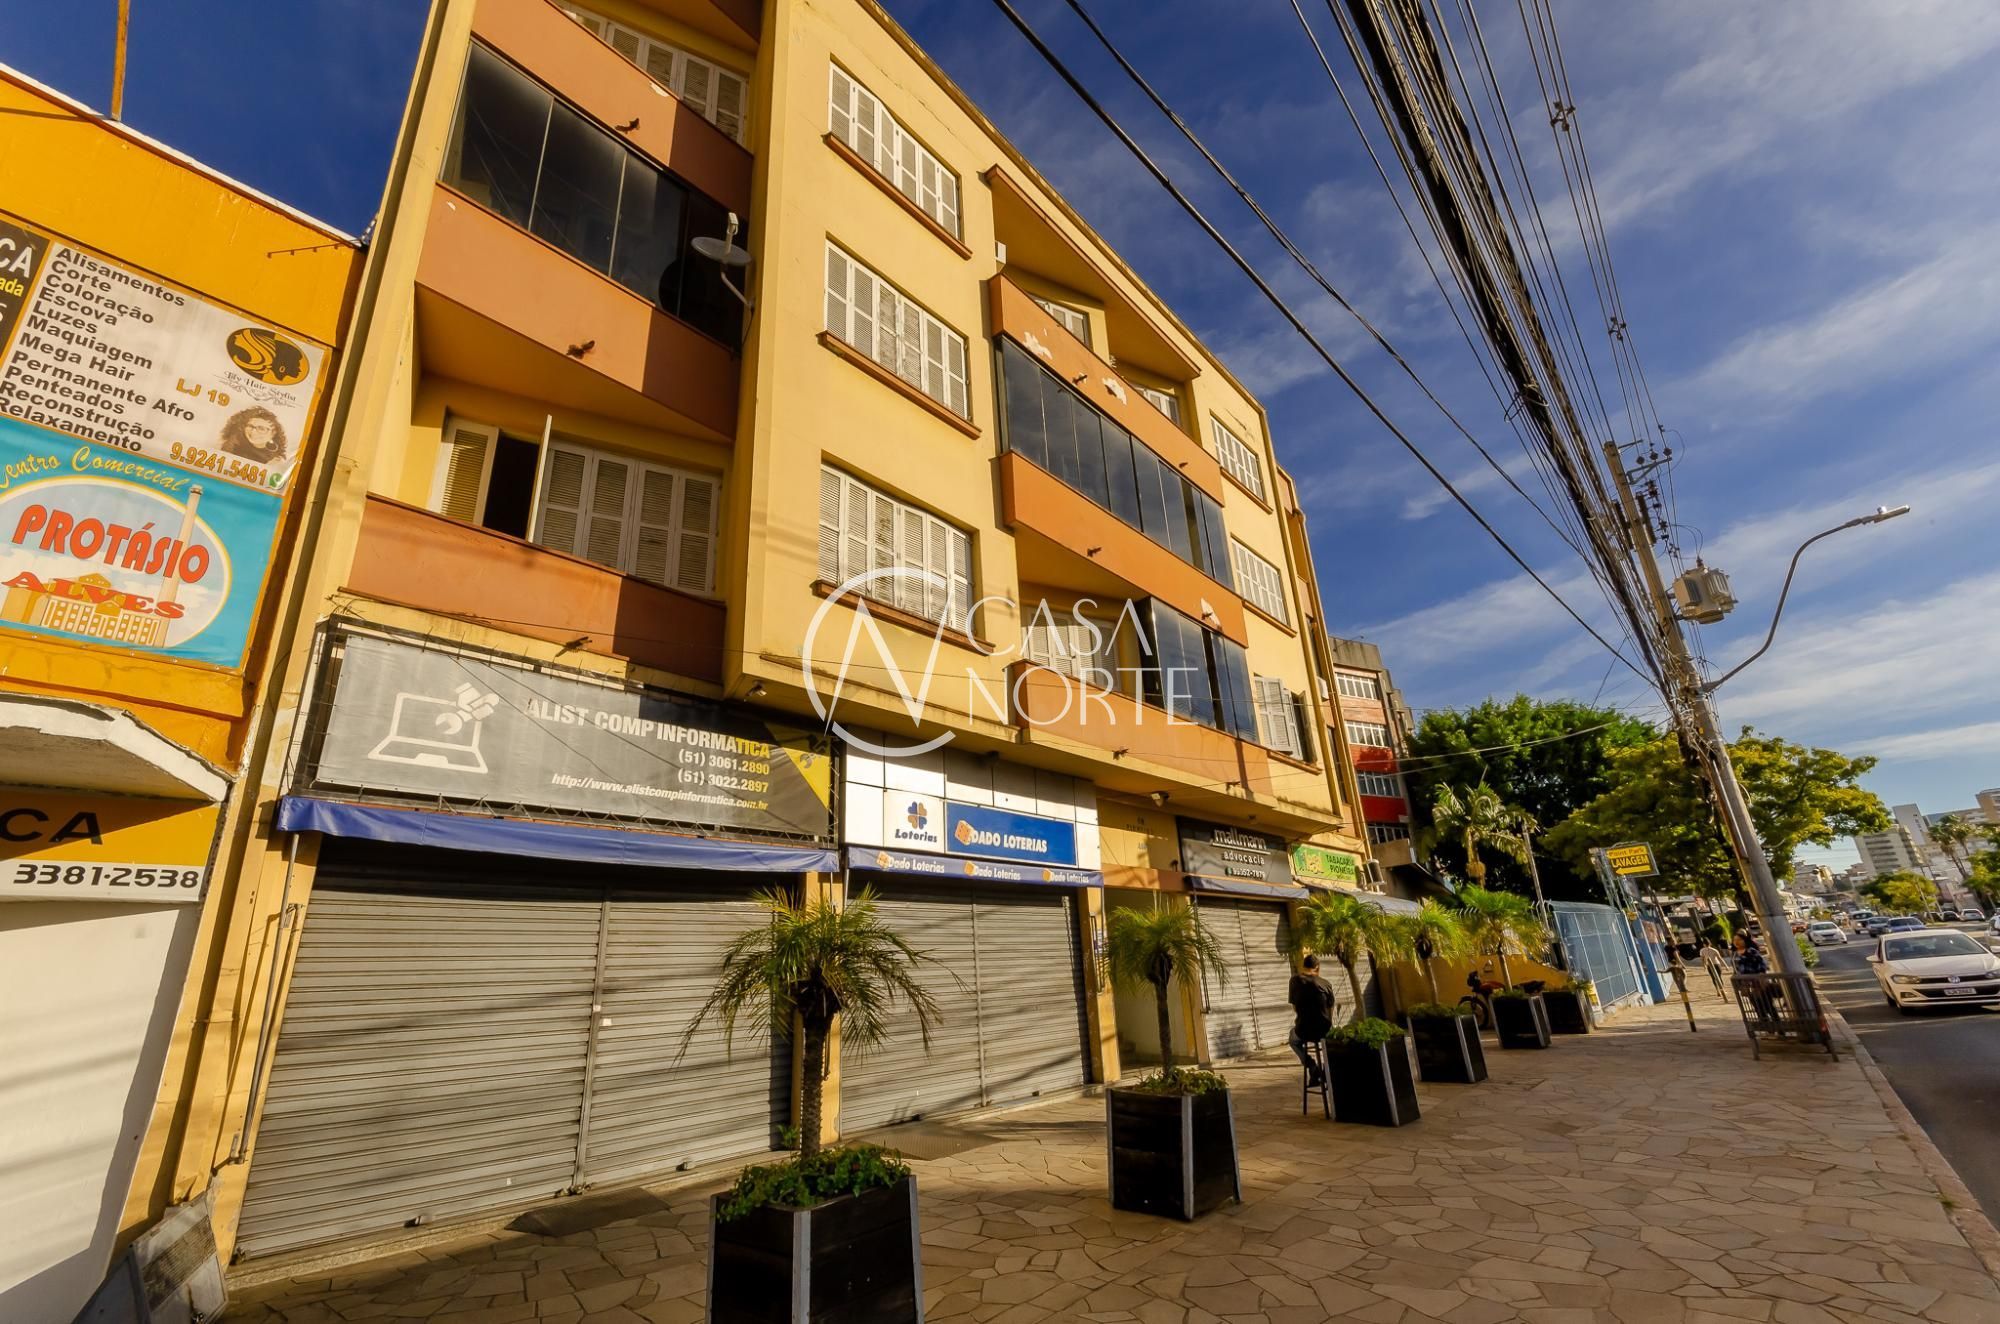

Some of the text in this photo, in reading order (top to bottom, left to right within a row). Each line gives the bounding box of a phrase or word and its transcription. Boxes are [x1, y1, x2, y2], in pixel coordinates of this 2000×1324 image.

[51, 260, 111, 293] Corte
[56, 247, 186, 307] Alisamentos
[32, 300, 98, 335] Luzes
[38, 286, 119, 327] Escova
[45, 273, 154, 325] Coloração
[19, 332, 136, 382] Mega Hair
[26, 314, 153, 370] Maquiagem
[5, 365, 125, 416] Penteados
[11, 350, 195, 422] Permanente Afro
[175, 377, 230, 408] LJ 19
[0, 380, 155, 441] Reconstrução
[0, 397, 142, 453] Relaxamento
[71, 444, 190, 491] Comercial
[170, 441, 268, 486] 9.9241.5481
[11, 504, 210, 585] PROTÁSIO
[1, 571, 186, 620] ALVES
[525, 698, 772, 759] ALIST COMP INFORMATICA
[677, 767, 769, 794] (51) 3022.2897
[678, 748, 771, 776] (51) 3061.2890
[0, 807, 104, 846] CA
[895, 828, 938, 843] Loterias
[970, 830, 1048, 852] DADO LOTERIAS
[1214, 827, 1267, 850] mallmann
[887, 856, 945, 874] Dado Loterias
[973, 864, 1021, 881] Dado Loterias
[1223, 850, 1265, 865] advocacia
[1611, 855, 1650, 869] LAVAGEM
[1066, 873, 1090, 883] Loterias
